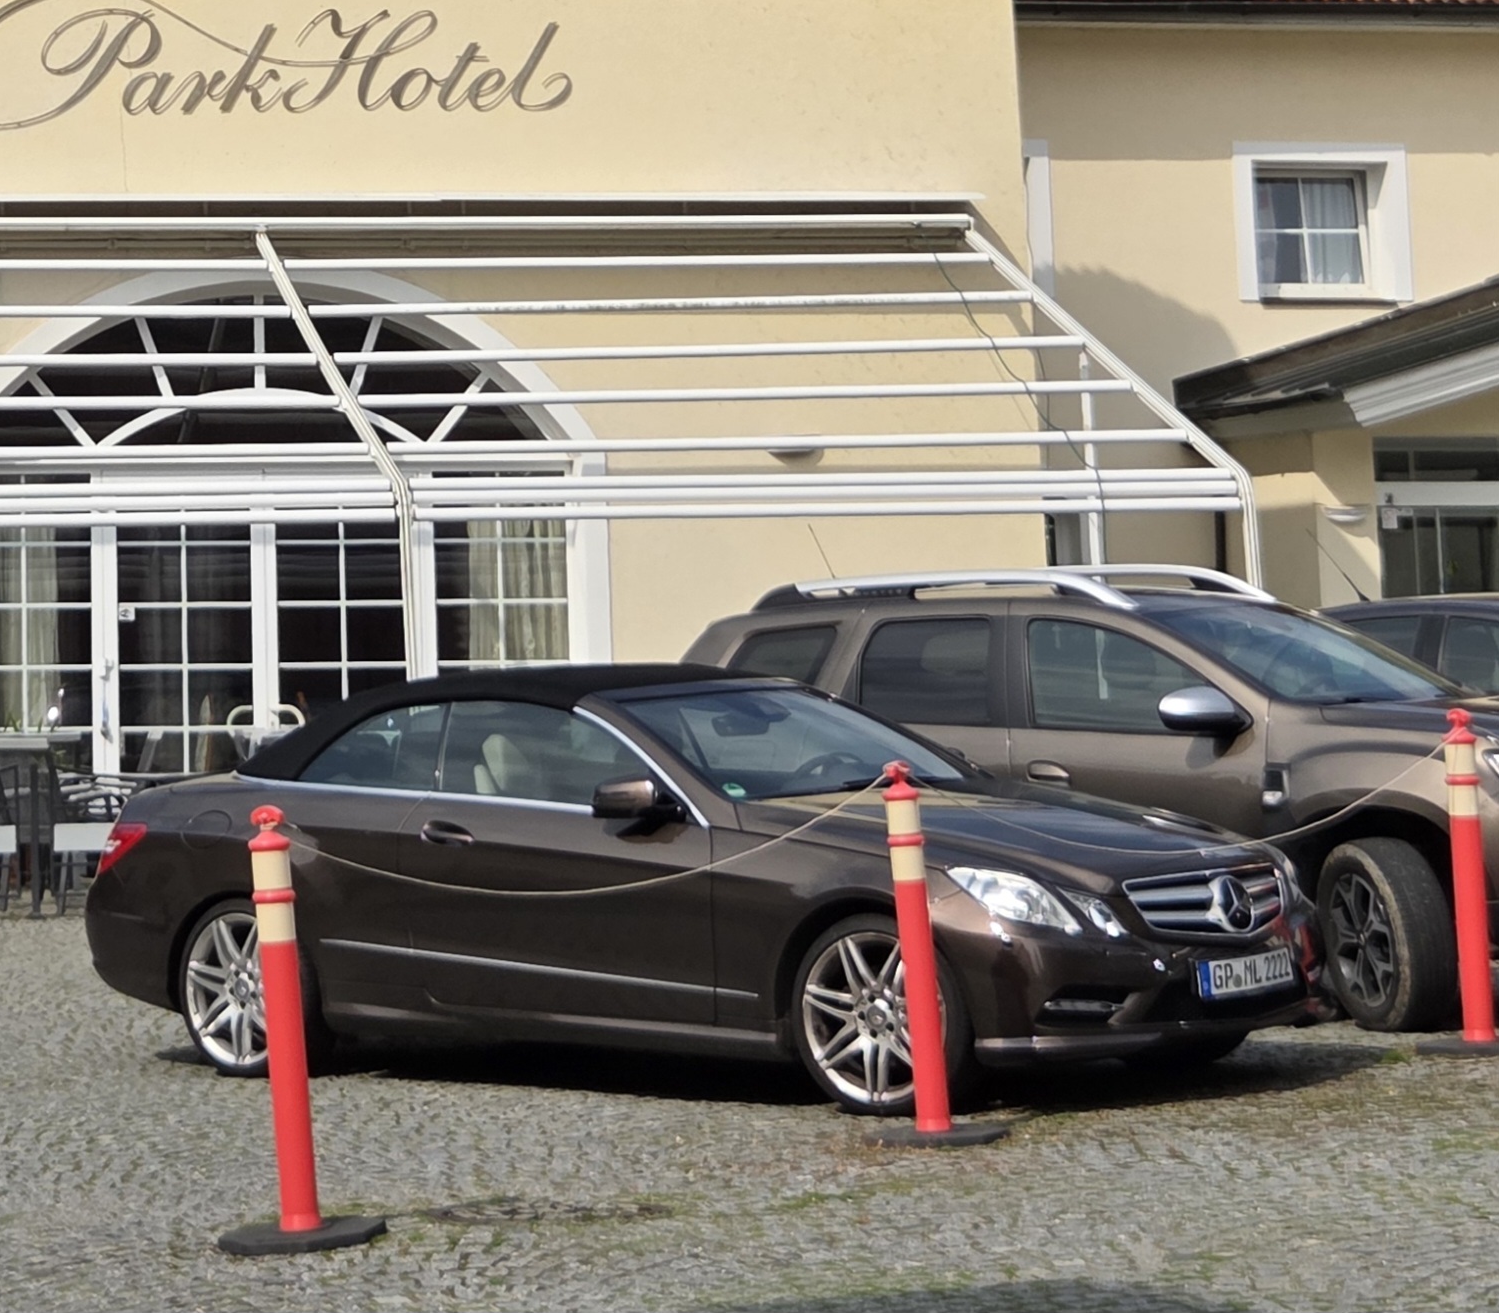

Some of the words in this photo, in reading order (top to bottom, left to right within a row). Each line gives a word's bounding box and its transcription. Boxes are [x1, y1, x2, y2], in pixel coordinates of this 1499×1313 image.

[281, 7, 573, 115] Hotel
[1213, 962, 1234, 989] GP
[1263, 951, 1290, 981] 2222
